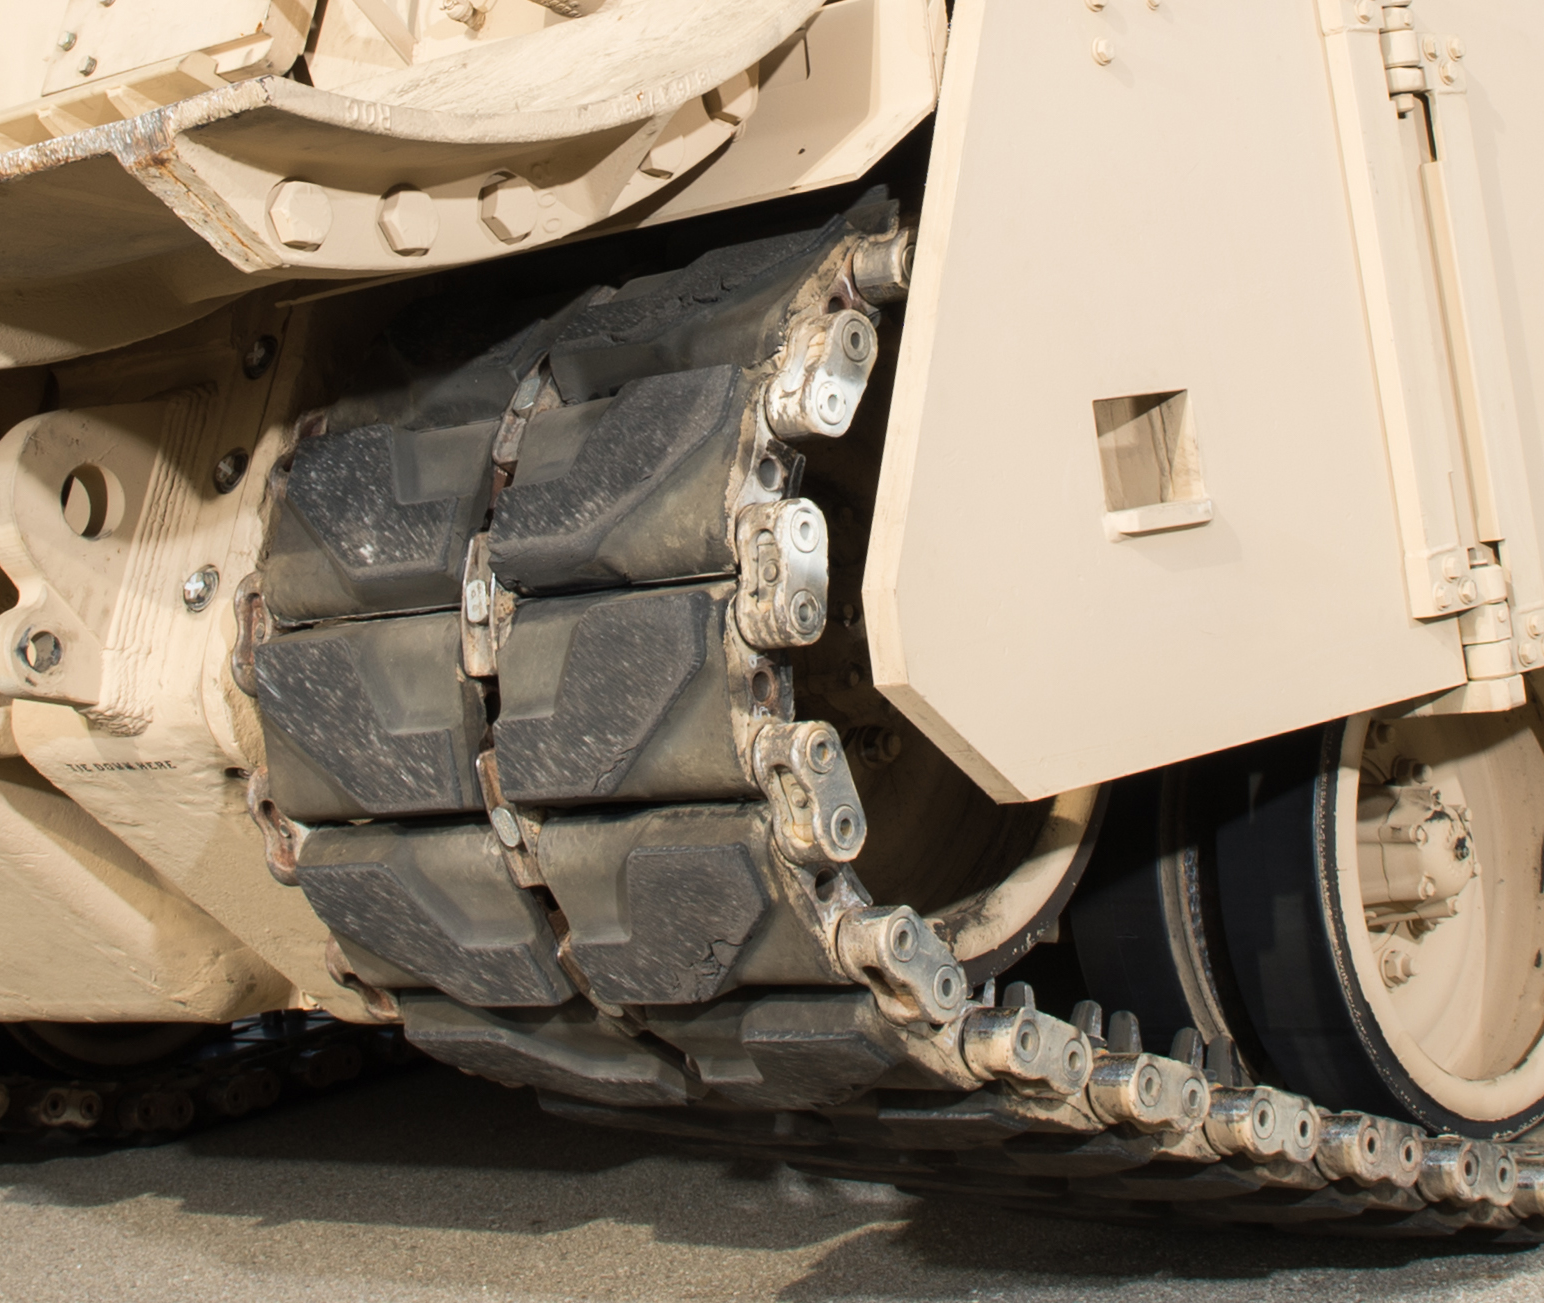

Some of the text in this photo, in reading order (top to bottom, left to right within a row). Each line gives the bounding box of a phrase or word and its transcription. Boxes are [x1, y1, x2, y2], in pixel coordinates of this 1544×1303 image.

[66, 760, 177, 773] TIE DOWN HERE
